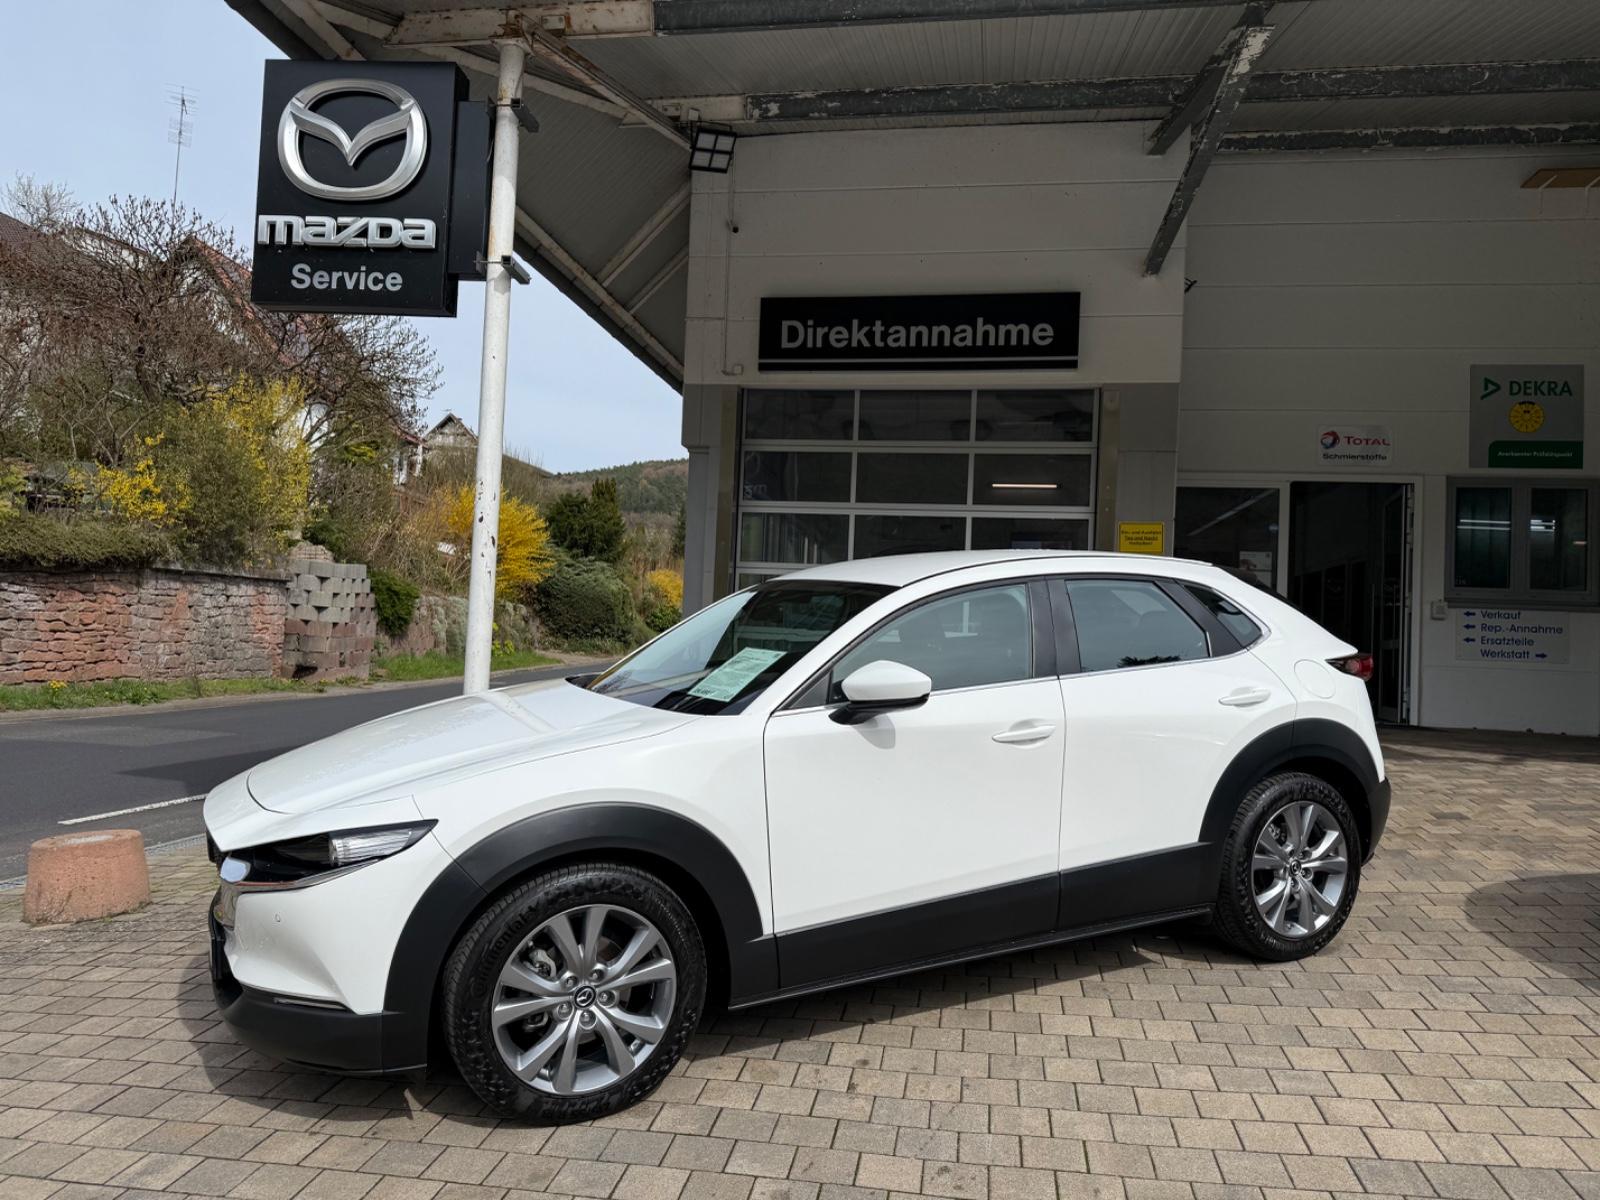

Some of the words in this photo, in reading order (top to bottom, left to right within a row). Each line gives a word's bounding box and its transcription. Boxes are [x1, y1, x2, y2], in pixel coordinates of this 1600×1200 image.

[257, 214, 436, 249] mazda
[290, 263, 403, 292] Service
[780, 317, 1055, 349] Direktannahme
[1509, 380, 1573, 397] DEKRA
[1344, 435, 1391, 446] TOTAL
[1322, 452, 1387, 461] Schmierstoffe
[1480, 610, 1521, 620] Verkauf
[1480, 623, 1564, 634] Rep.-Annahme
[1480, 636, 1535, 646] Ersatzteile
[1480, 648, 1530, 659] Werkstatt
